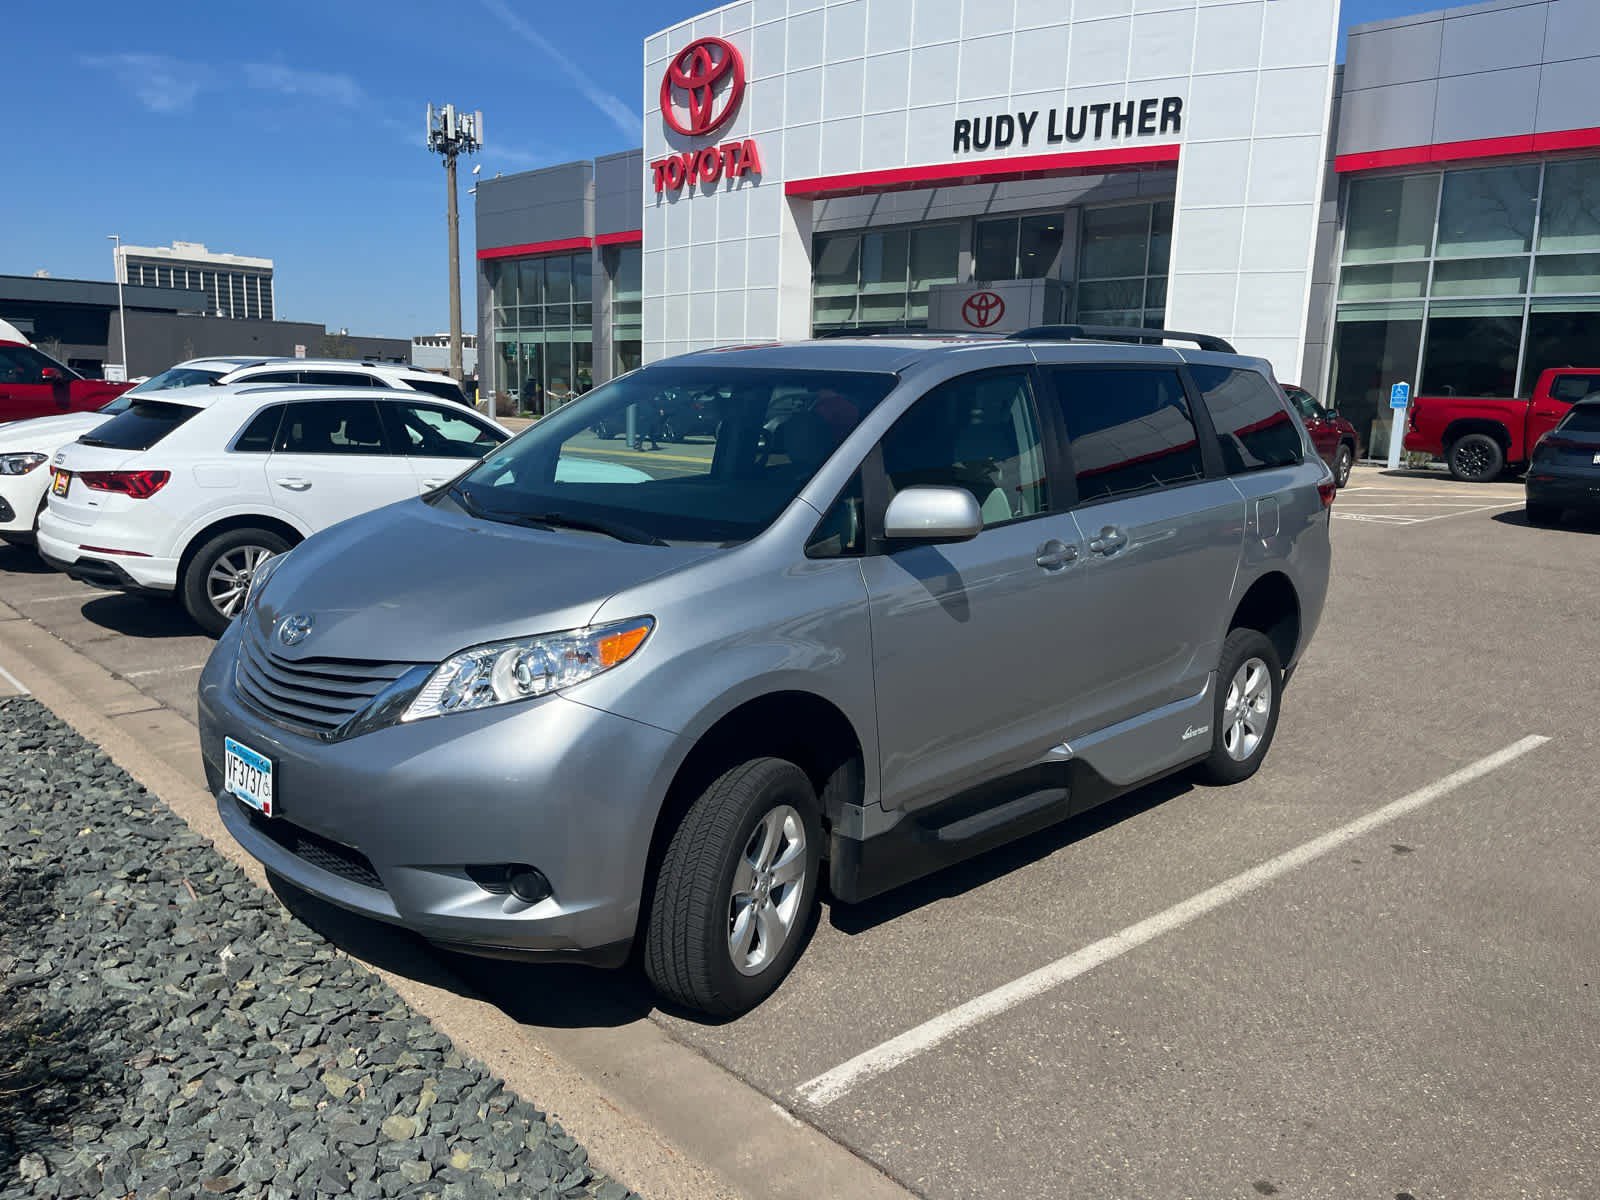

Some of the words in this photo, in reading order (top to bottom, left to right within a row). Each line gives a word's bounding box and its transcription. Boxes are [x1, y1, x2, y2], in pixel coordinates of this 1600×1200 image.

[953, 111, 1039, 152] RUDY
[1047, 96, 1183, 144] LUTHER
[650, 139, 762, 193] TOYOTA
[227, 752, 262, 798] VF3737
